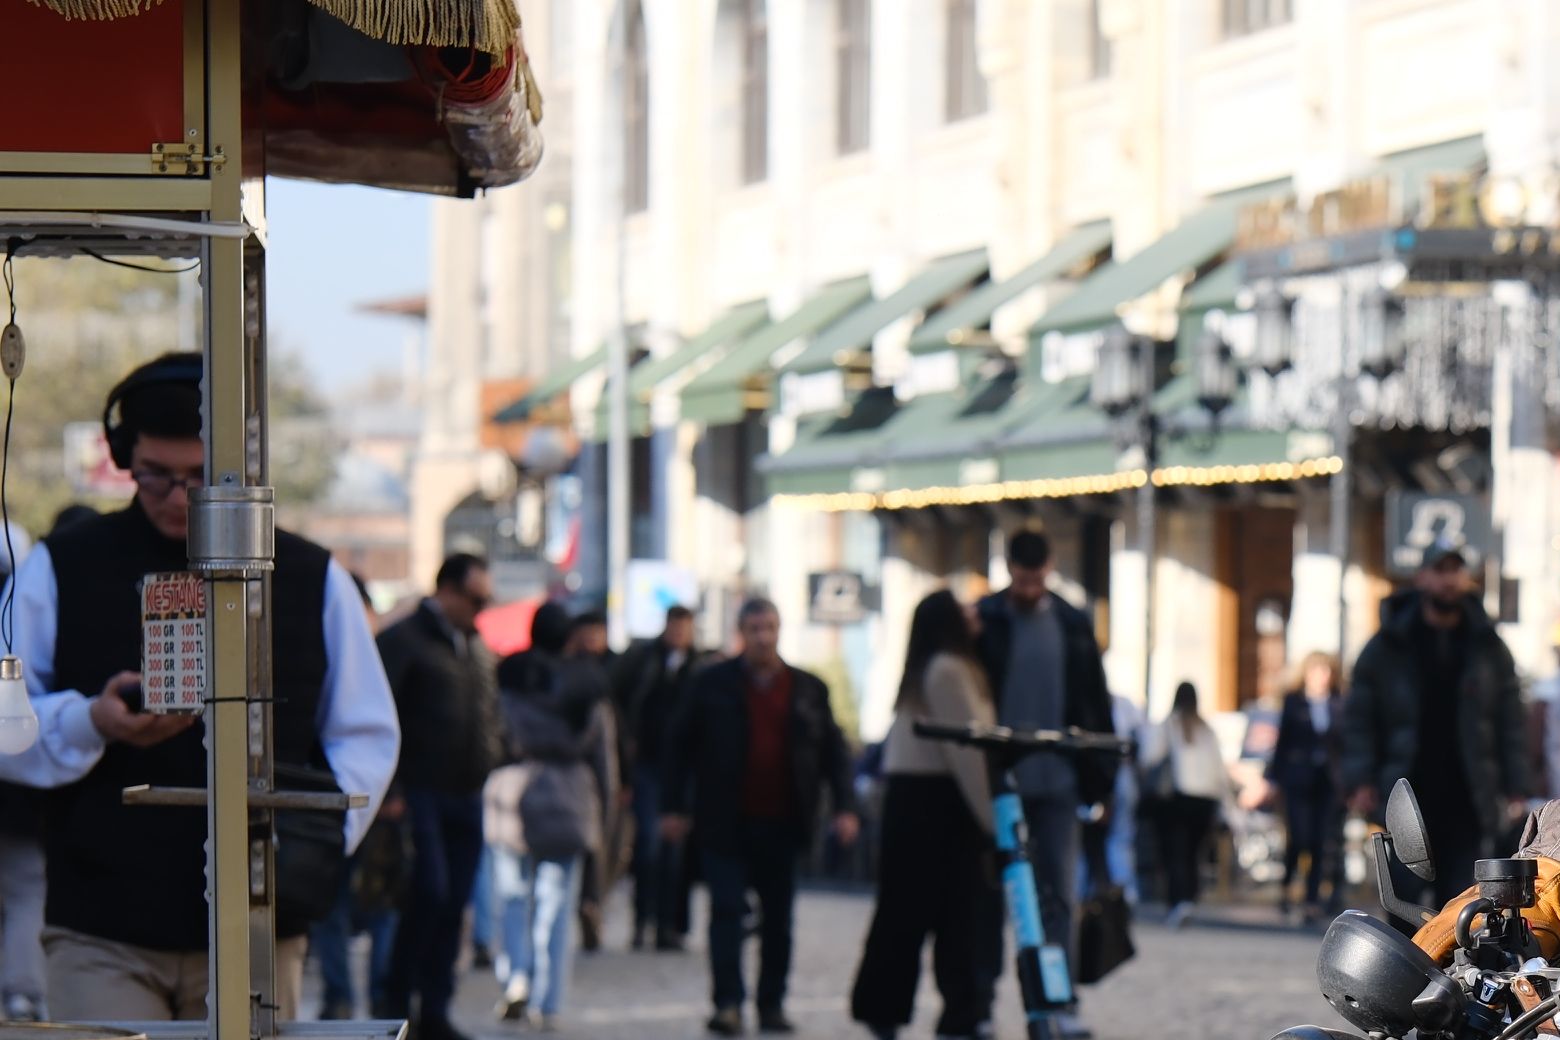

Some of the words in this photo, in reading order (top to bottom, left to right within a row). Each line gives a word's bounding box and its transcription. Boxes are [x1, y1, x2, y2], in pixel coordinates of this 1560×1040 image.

[145, 582, 206, 613] KESTANE
[163, 624, 175, 636] GR
[181, 624, 194, 636] 100
[196, 623, 204, 636] TL
[163, 642, 175, 654] GR
[181, 642, 194, 654] 200
[196, 641, 204, 654] TL
[163, 659, 175, 671] GR
[181, 659, 194, 671] 300
[196, 658, 204, 671] TL
[163, 676, 175, 688] GR
[181, 676, 194, 688] 400
[196, 675, 204, 688] TL
[163, 692, 175, 704] GR
[181, 692, 194, 704] 500
[196, 691, 204, 704] TL
